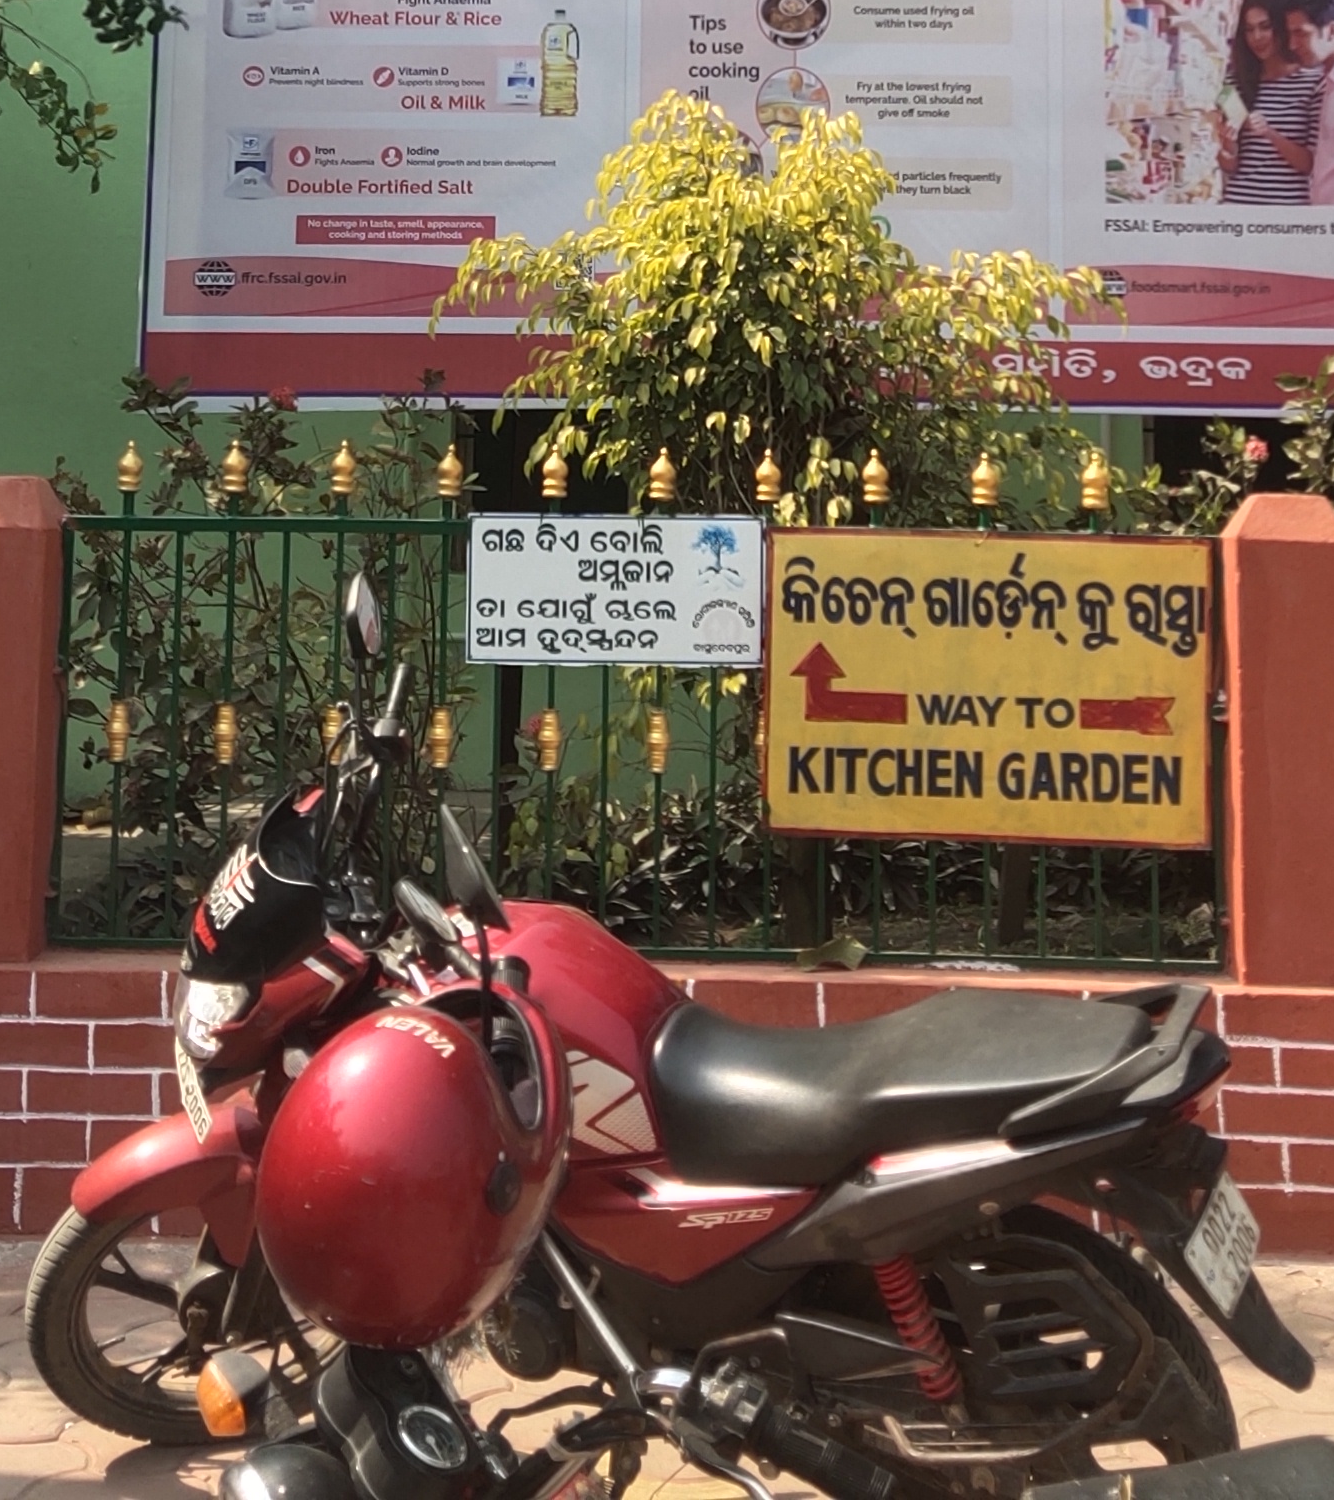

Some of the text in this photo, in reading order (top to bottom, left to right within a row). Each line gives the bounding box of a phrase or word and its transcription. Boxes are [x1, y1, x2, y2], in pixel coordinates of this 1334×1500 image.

[330, 11, 502, 26] Wheat Flour & Rice
[854, 6, 974, 18] Consume used frying oil
[689, 15, 727, 32] Tips
[875, 19, 953, 31] within two days
[689, 40, 744, 55] to use
[689, 62, 760, 83] cooking
[689, 86, 710, 101] oil
[857, 83, 971, 94] Fry at the lowest frying
[402, 96, 485, 110] Oil & Milk
[315, 146, 336, 155] Iron
[902, 173, 1001, 183] particles frequently
[287, 179, 473, 195] Double Fortified Salt
[329, 231, 462, 241] cooking and storing methods
[1139, 356, 1251, 386] ଭଦ୍ରକ
[482, 523, 664, 555] ଗଛ ଦିଏ ବୋଲି
[476, 599, 506, 618] ତା
[1076, 582, 1118, 650] କୁ
[476, 627, 526, 648] ଆମ
[916, 694, 1075, 729] WAY TO
[788, 745, 1182, 805] KITCHEN GARDEN
